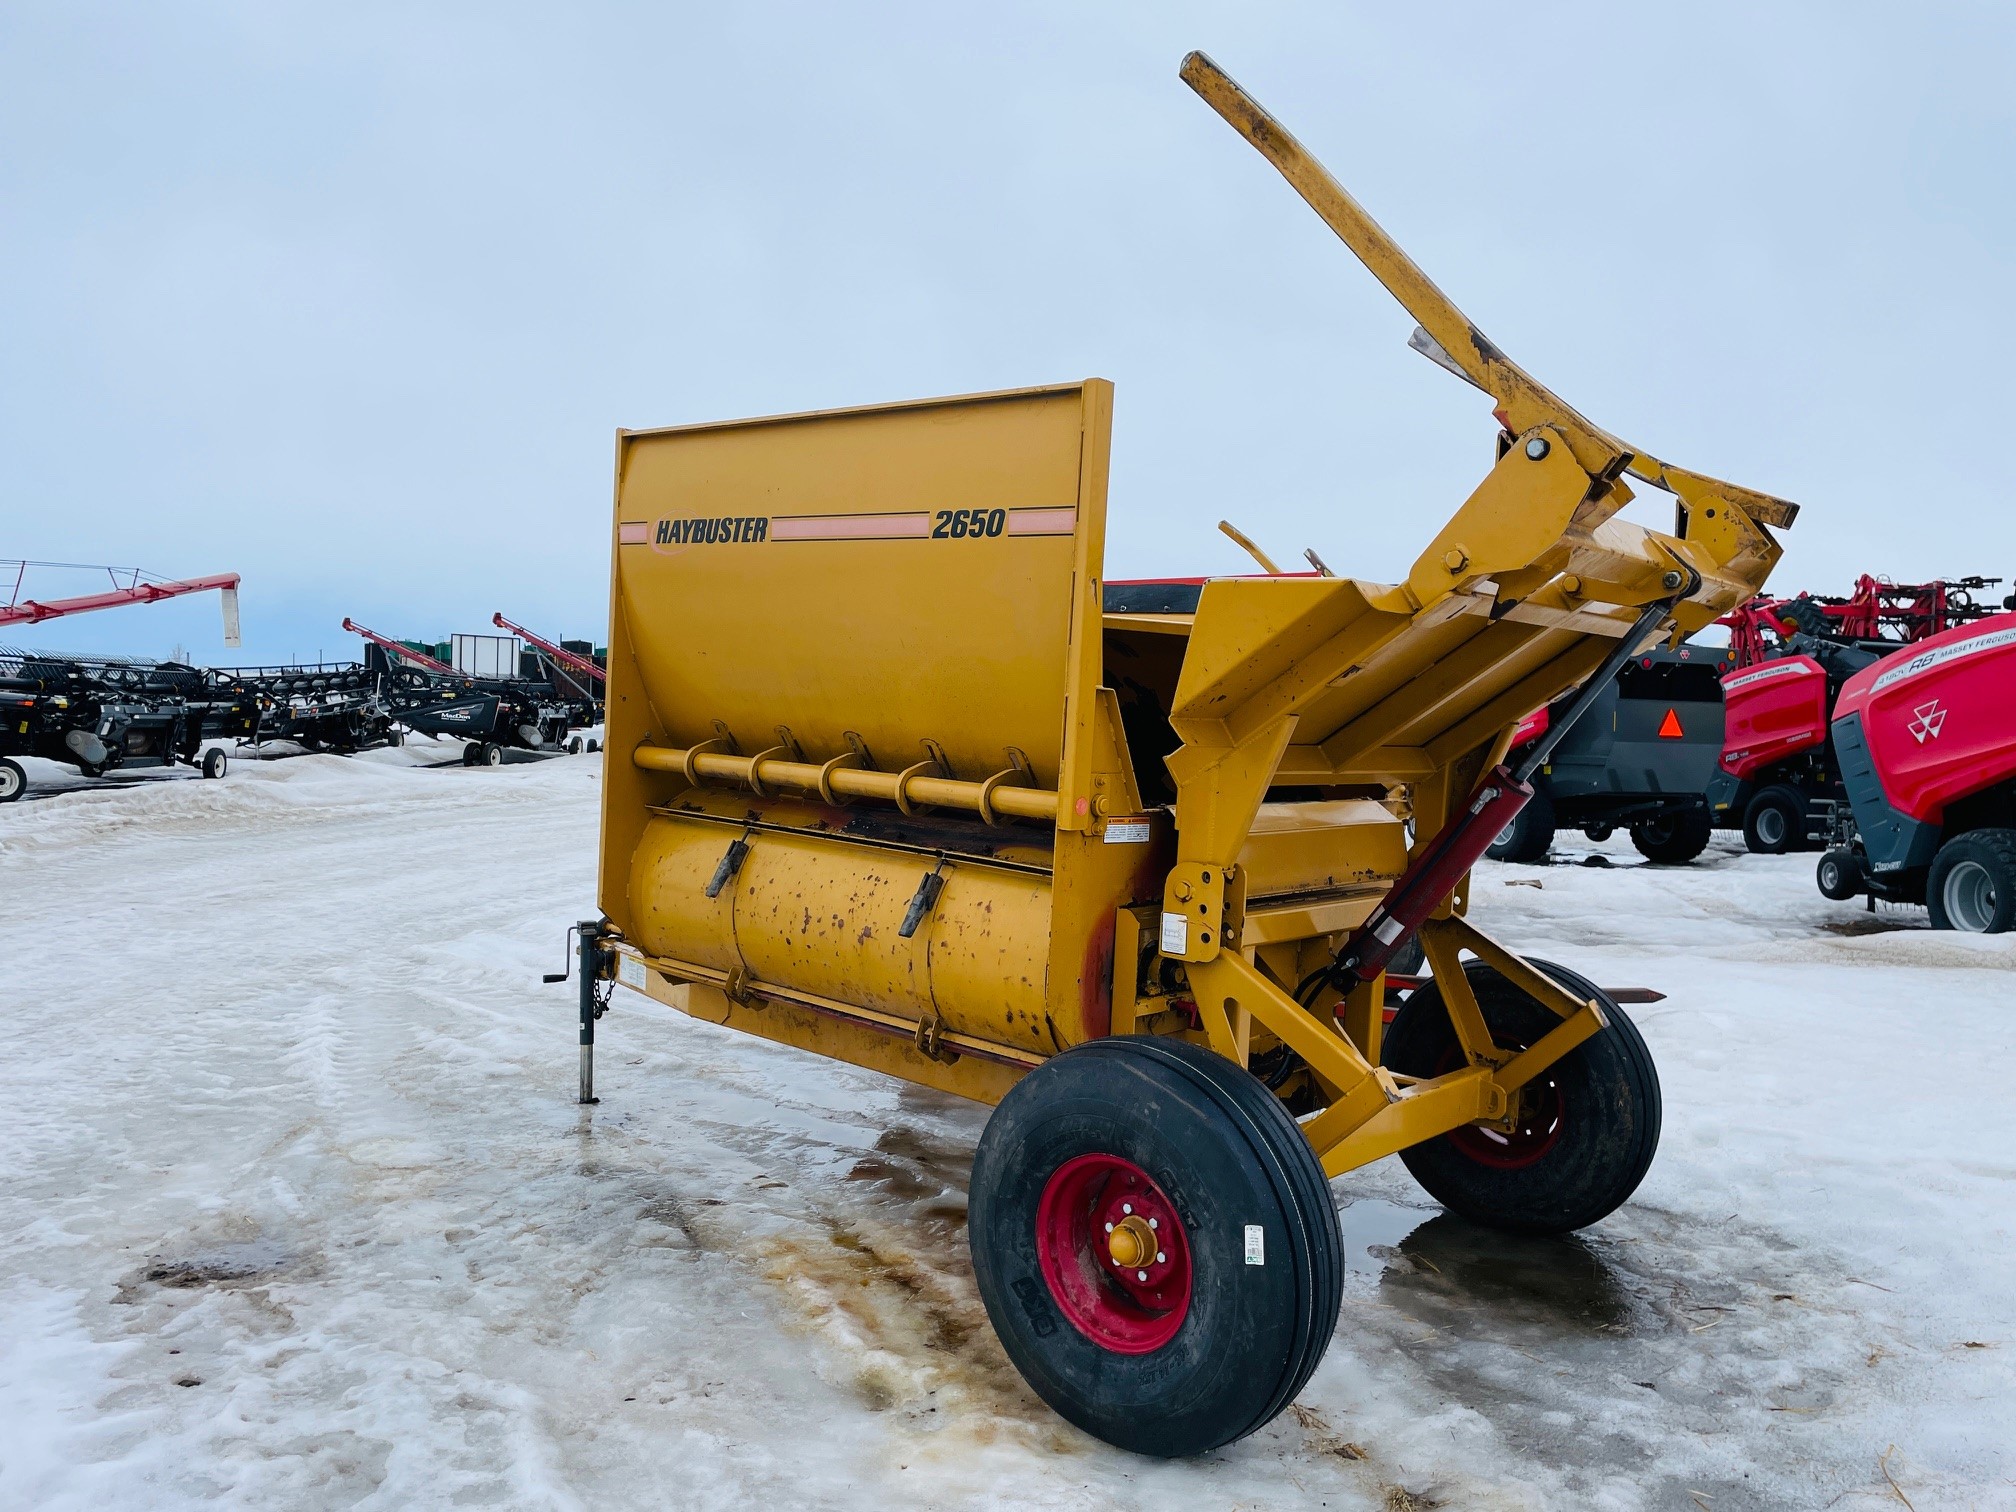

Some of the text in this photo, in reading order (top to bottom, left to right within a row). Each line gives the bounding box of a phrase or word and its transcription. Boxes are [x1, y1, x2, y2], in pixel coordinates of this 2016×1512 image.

[655, 517, 769, 544] HAYBUSTER
[932, 508, 1006, 539] 2650
[1940, 642, 1973, 658] MASSEY
[441, 712, 471, 720] MacDon
